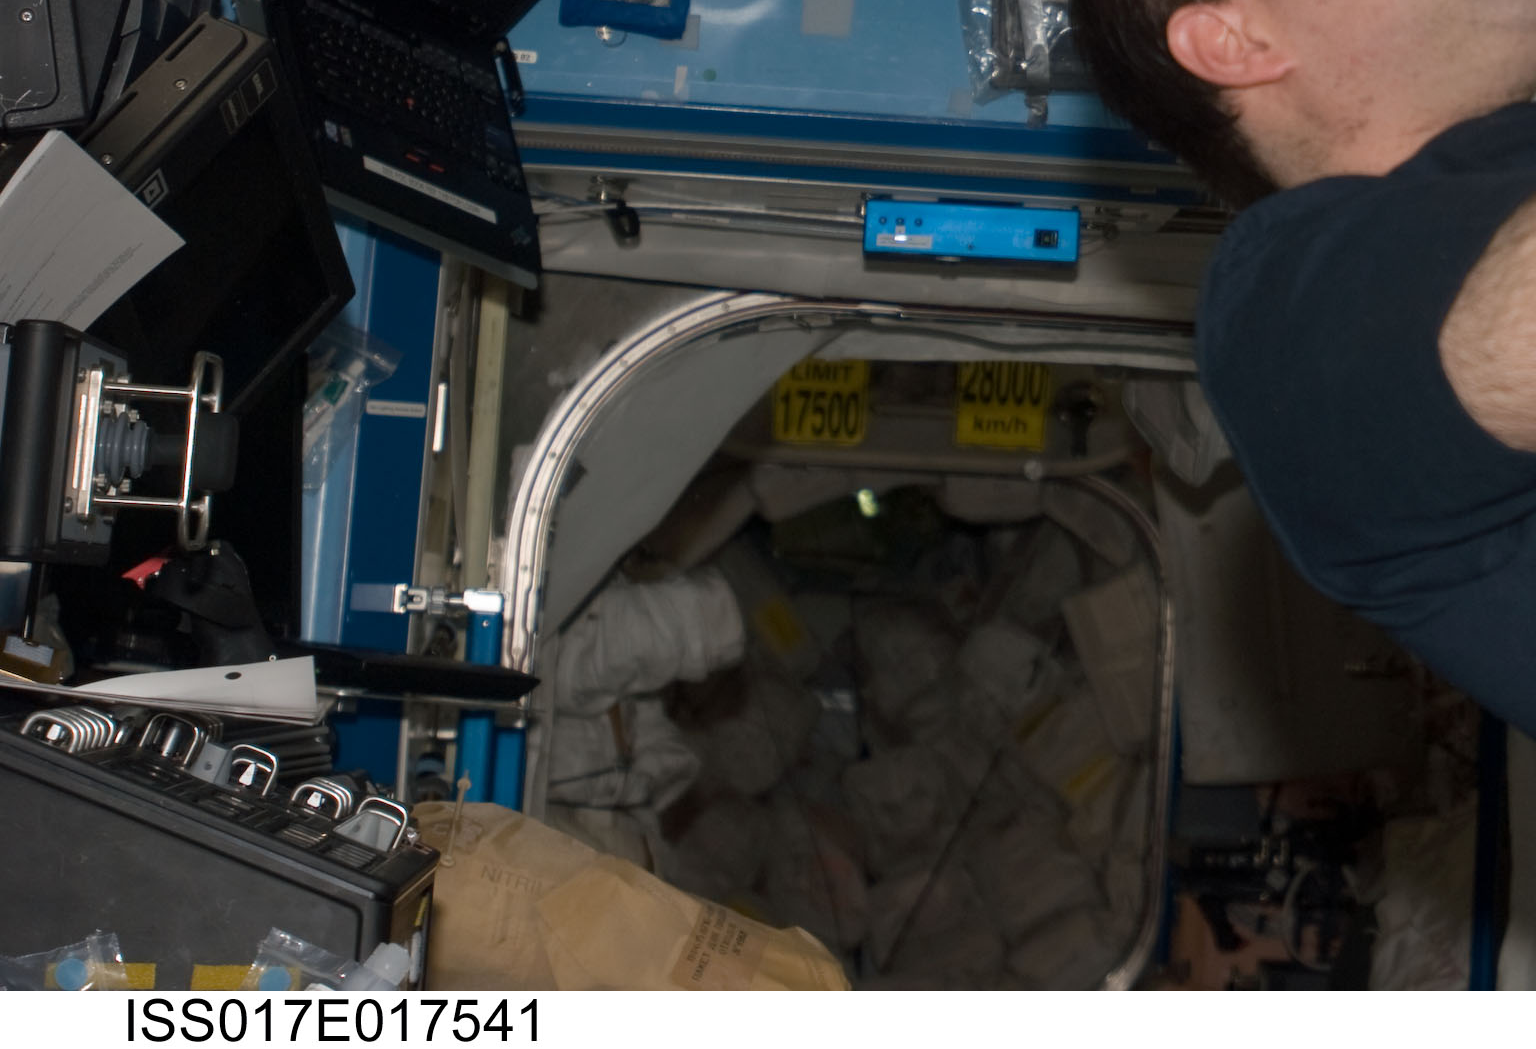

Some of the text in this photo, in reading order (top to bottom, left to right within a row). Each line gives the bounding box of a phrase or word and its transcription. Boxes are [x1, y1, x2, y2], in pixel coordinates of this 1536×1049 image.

[959, 362, 1044, 407] 28000
[779, 389, 860, 439] 17500
[972, 413, 1029, 435] km/h
